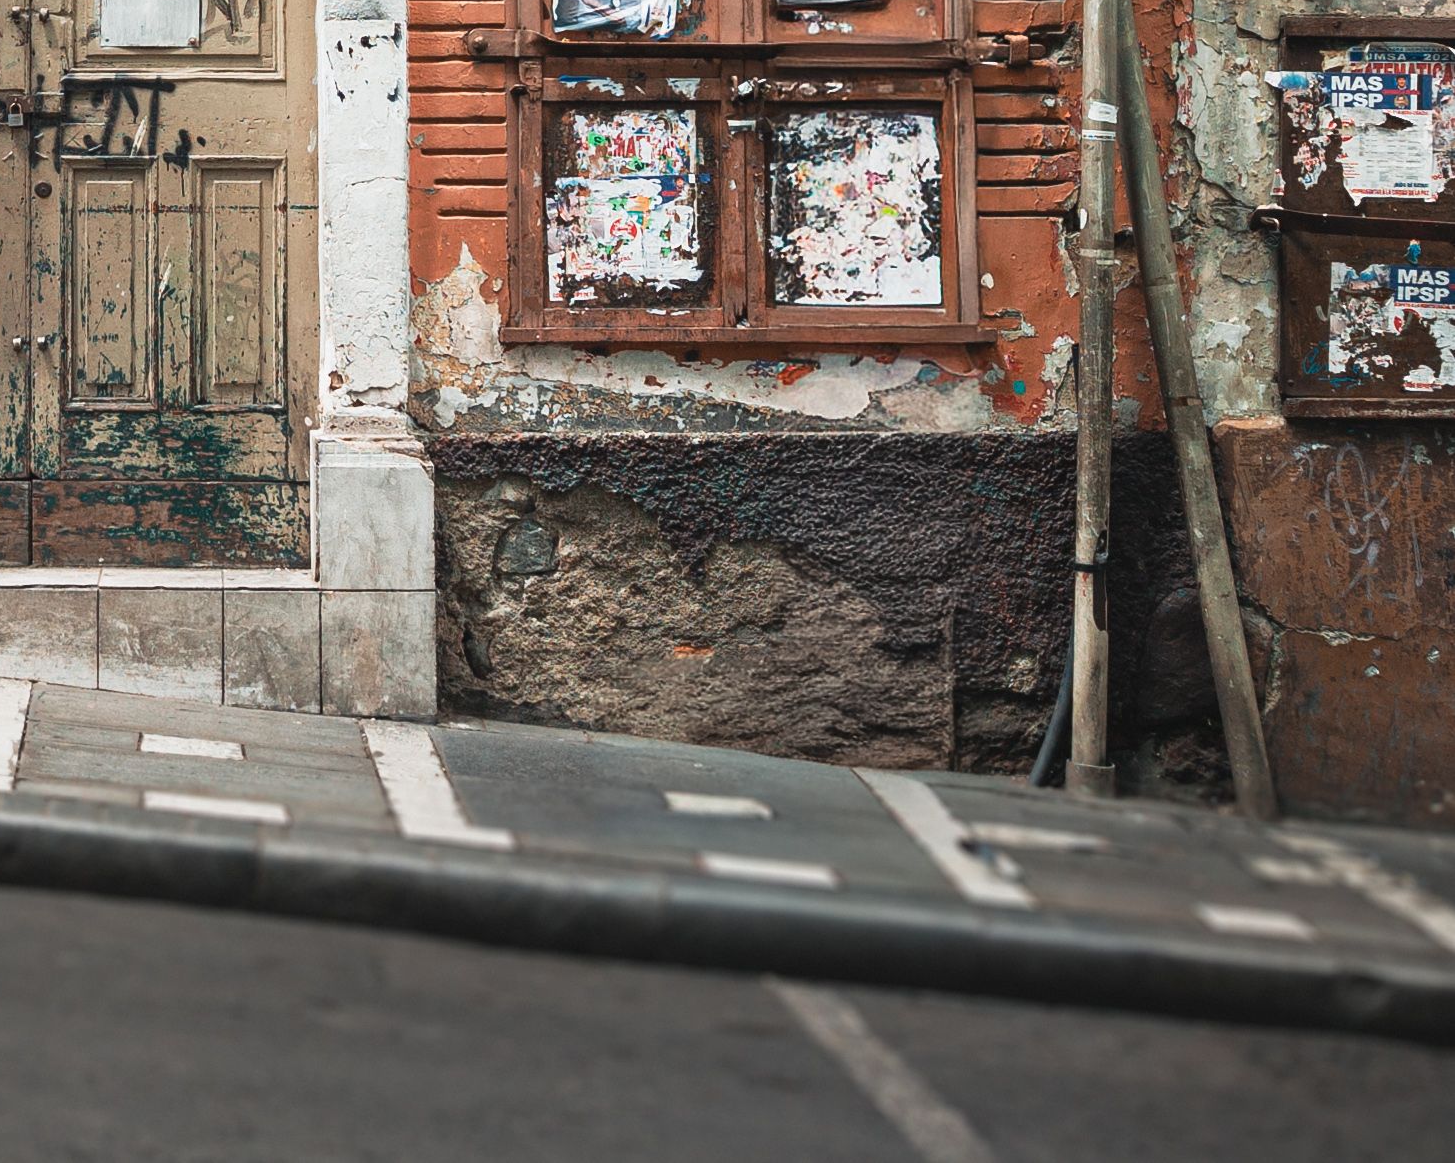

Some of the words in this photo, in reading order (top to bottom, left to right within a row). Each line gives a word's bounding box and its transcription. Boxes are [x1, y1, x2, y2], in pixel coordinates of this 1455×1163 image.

[1351, 63, 1454, 79] ATEMATICA
[1331, 75, 1384, 91] MAS
[1331, 92, 1384, 108] IPSP
[1398, 268, 1450, 285] MAS
[1397, 286, 1450, 302] IPSP
